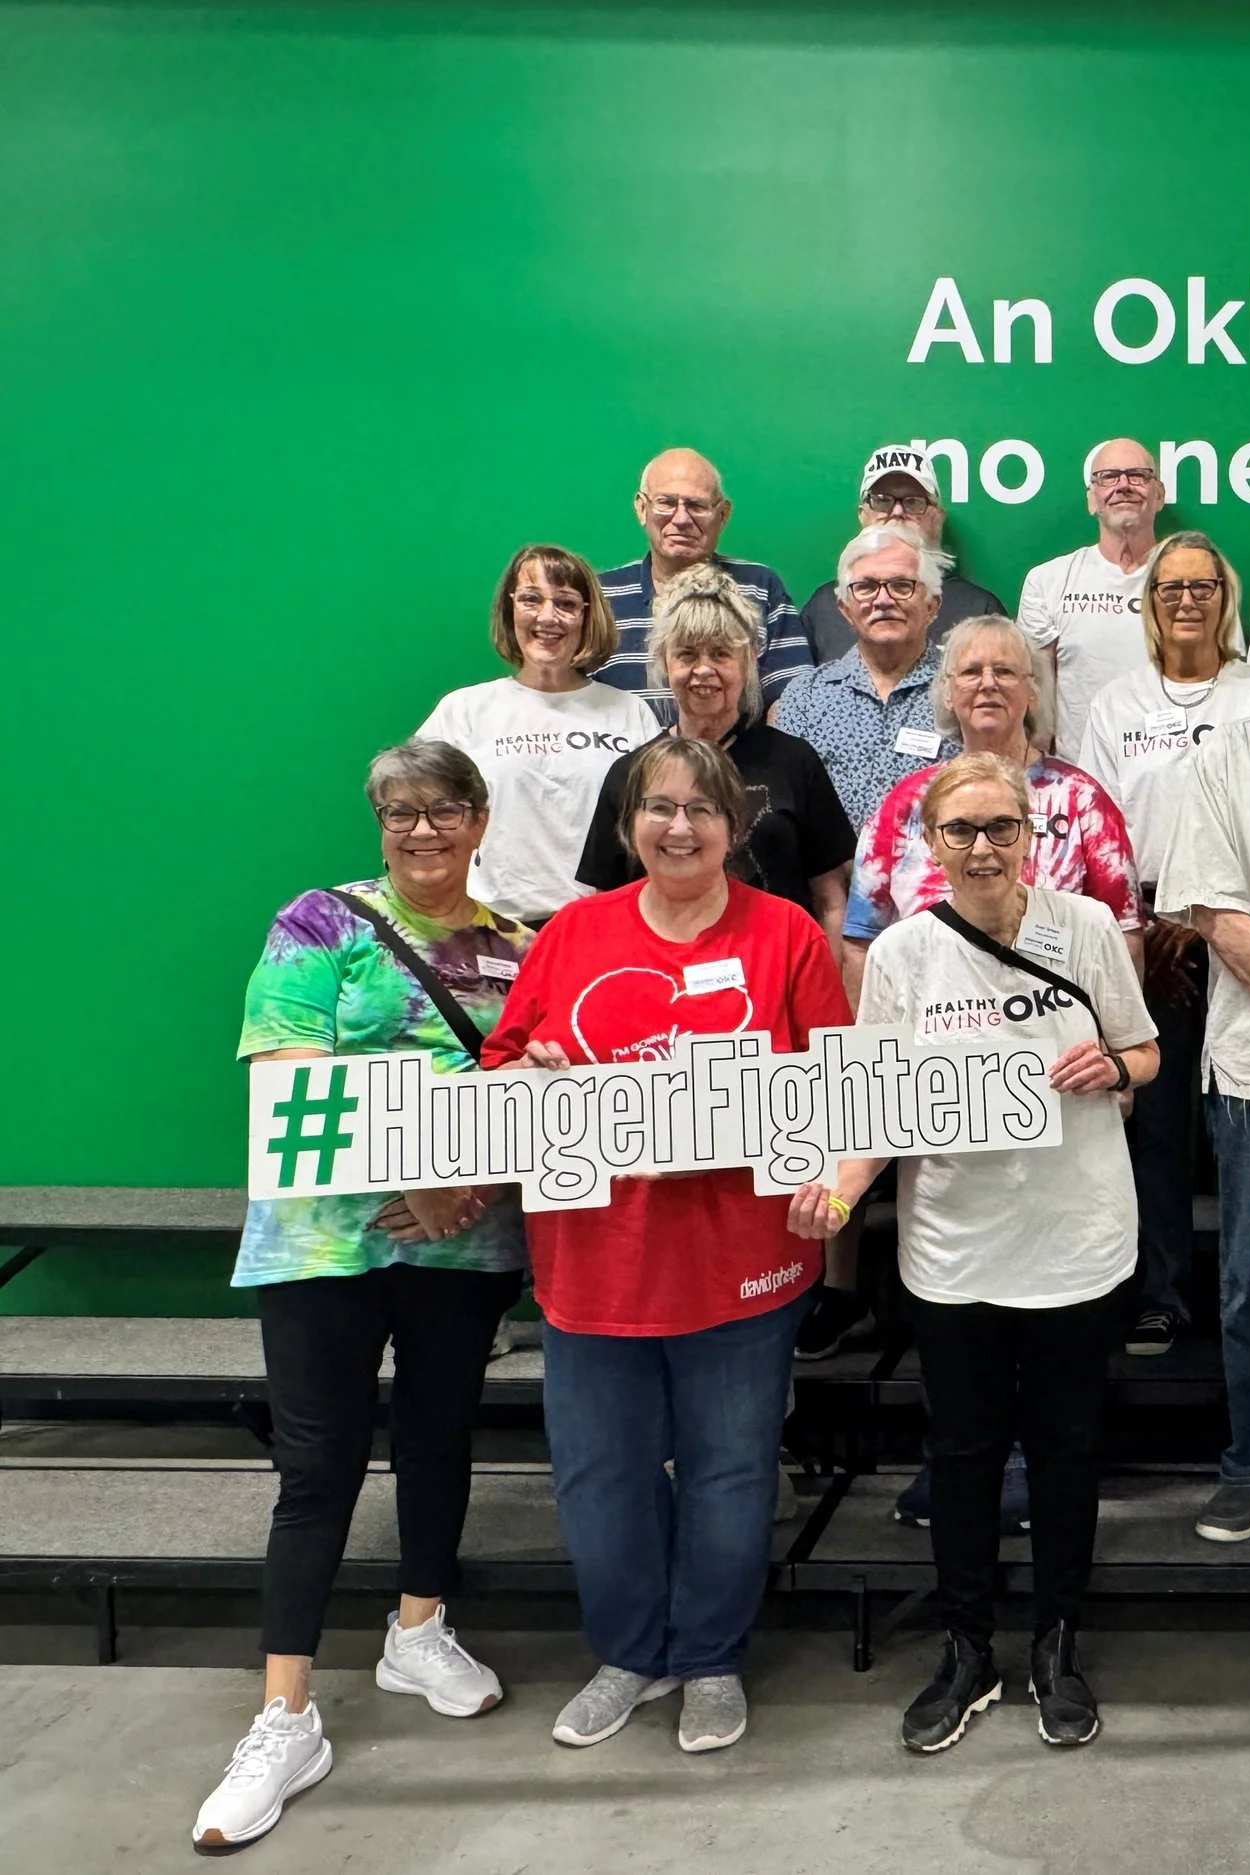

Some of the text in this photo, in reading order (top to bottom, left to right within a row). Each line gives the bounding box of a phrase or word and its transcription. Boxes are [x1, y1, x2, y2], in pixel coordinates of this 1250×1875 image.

[907, 277, 1053, 364] An
[875, 451, 924, 473] NAVY
[911, 438, 1045, 504] no
[1062, 602, 1124, 615] LIVING
[1063, 592, 1124, 604] HEALTHY
[495, 732, 561, 746] HEALTHY
[496, 742, 563, 757] LIVING
[565, 731, 630, 754] OKC
[1123, 736, 1189, 758] LIVING
[1044, 943, 1064, 955] OKC
[925, 997, 997, 1018] HEALTHY
[1003, 986, 1074, 1022] OKC
[925, 1012, 1002, 1034] LIVING
[267, 1034, 1047, 1202] #HungerFighters
[740, 1269, 772, 1300] david
